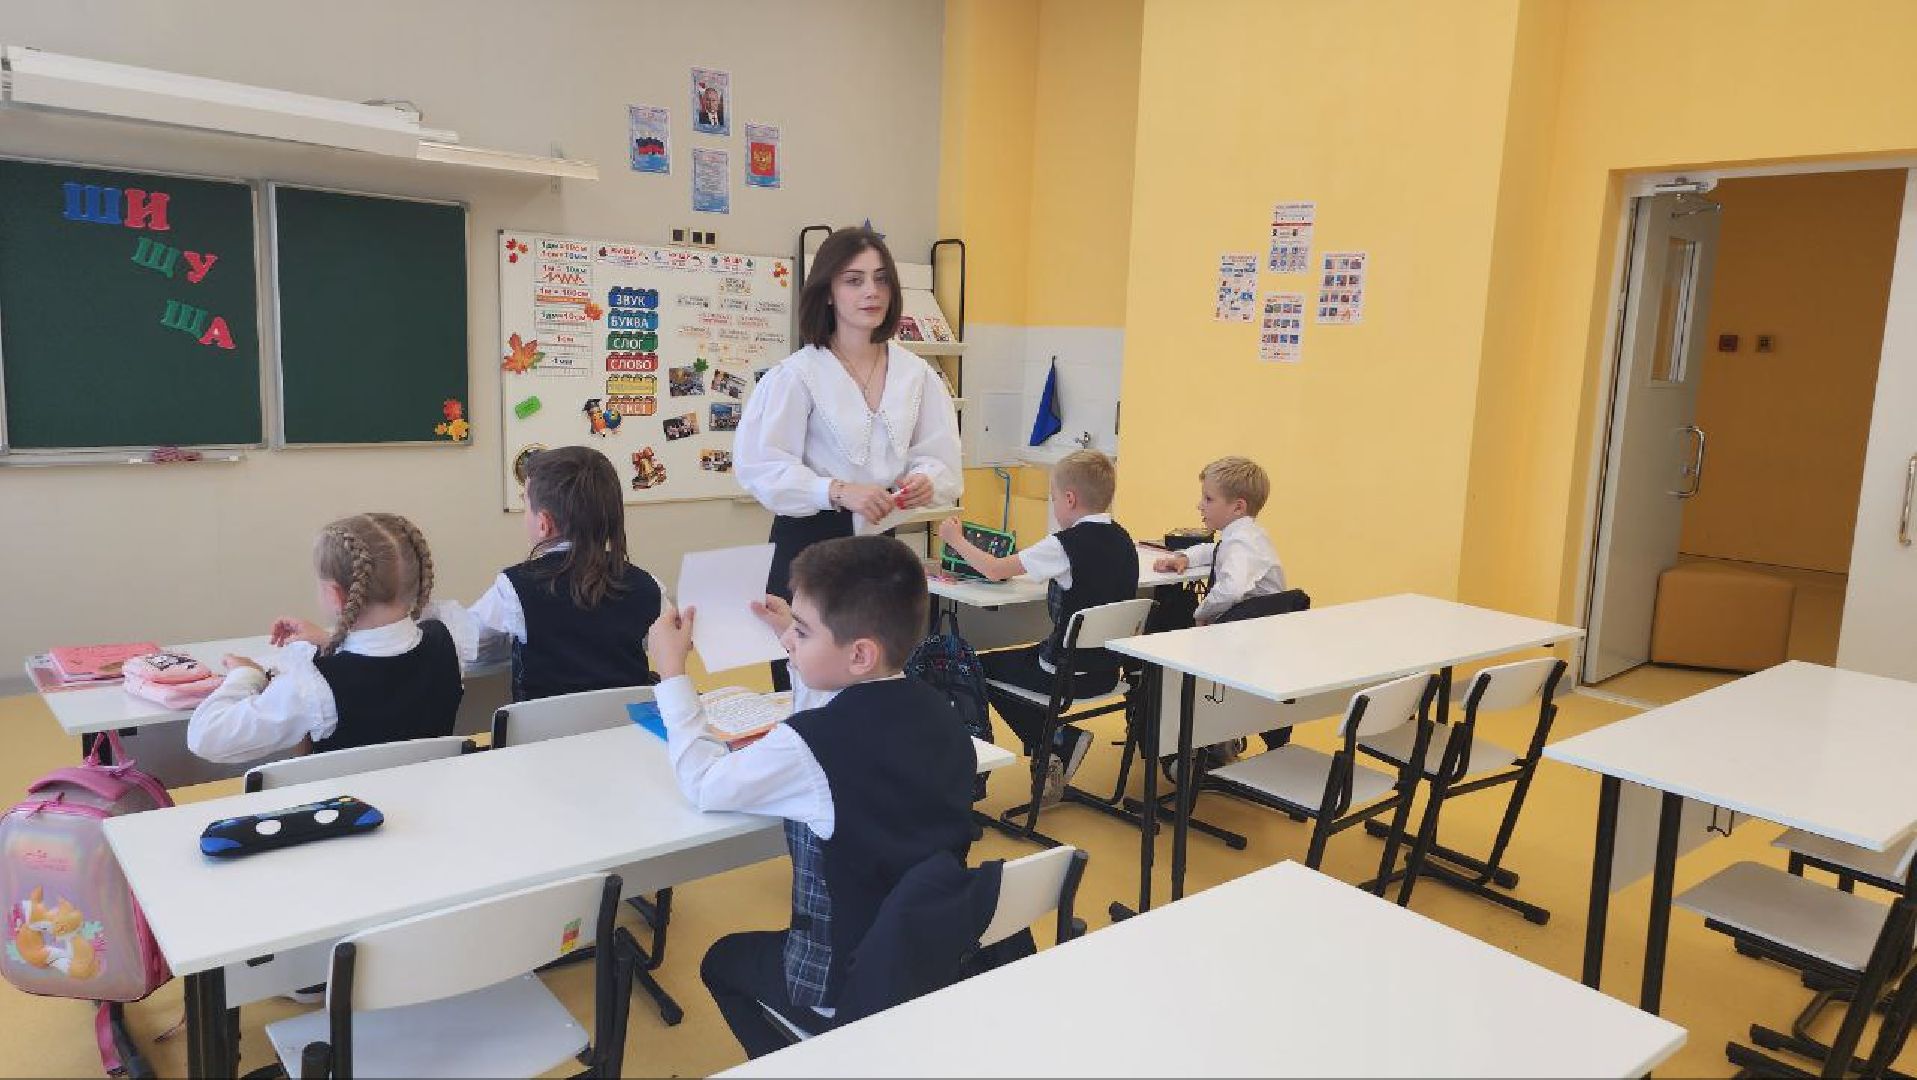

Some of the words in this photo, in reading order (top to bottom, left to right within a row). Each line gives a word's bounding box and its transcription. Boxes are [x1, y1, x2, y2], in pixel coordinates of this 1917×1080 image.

[63, 182, 170, 231] ШИ
[130, 236, 218, 284] ЩУ
[616, 294, 646, 306] ЗВУК
[611, 315, 649, 329] БУКВА
[613, 337, 644, 350] СЛОГ
[610, 359, 652, 370] СЛОВО
